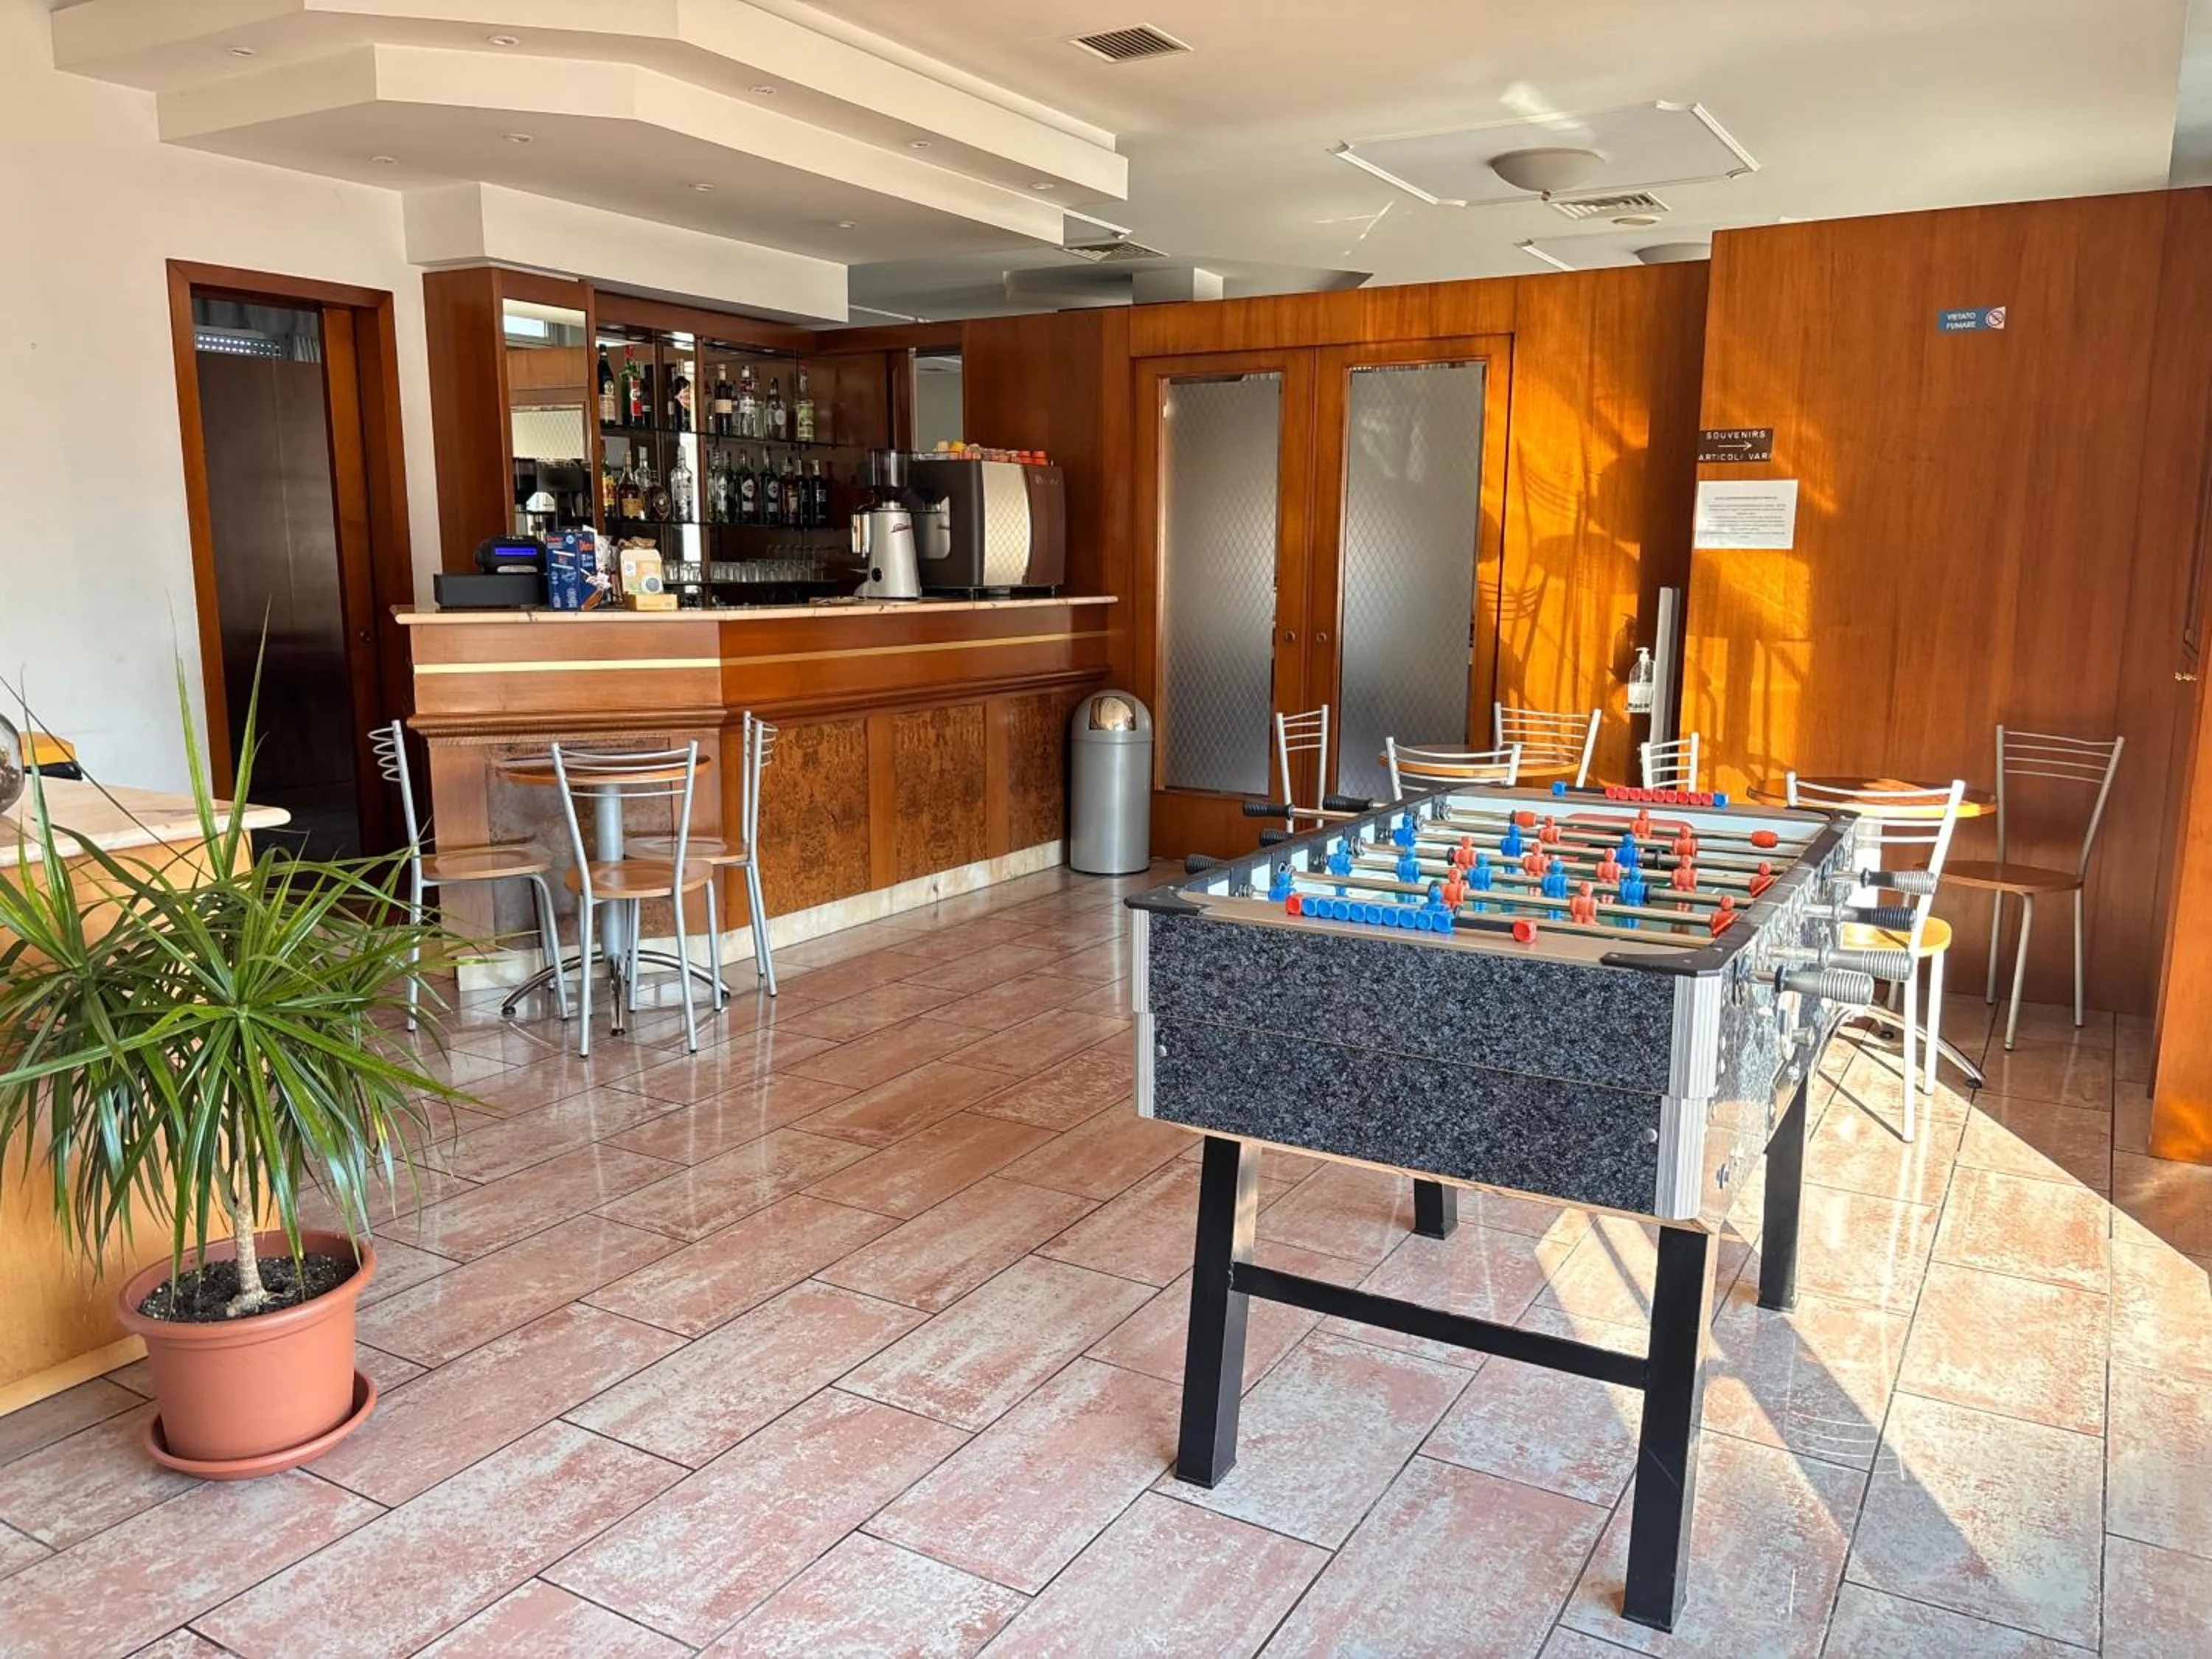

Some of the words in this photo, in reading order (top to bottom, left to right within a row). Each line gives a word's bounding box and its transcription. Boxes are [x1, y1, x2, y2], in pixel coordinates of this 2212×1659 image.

[1947, 312, 1977, 321] VIETATO
[1946, 321, 1976, 330] FUMARE
[1705, 430, 1766, 440] SOUVENIRS
